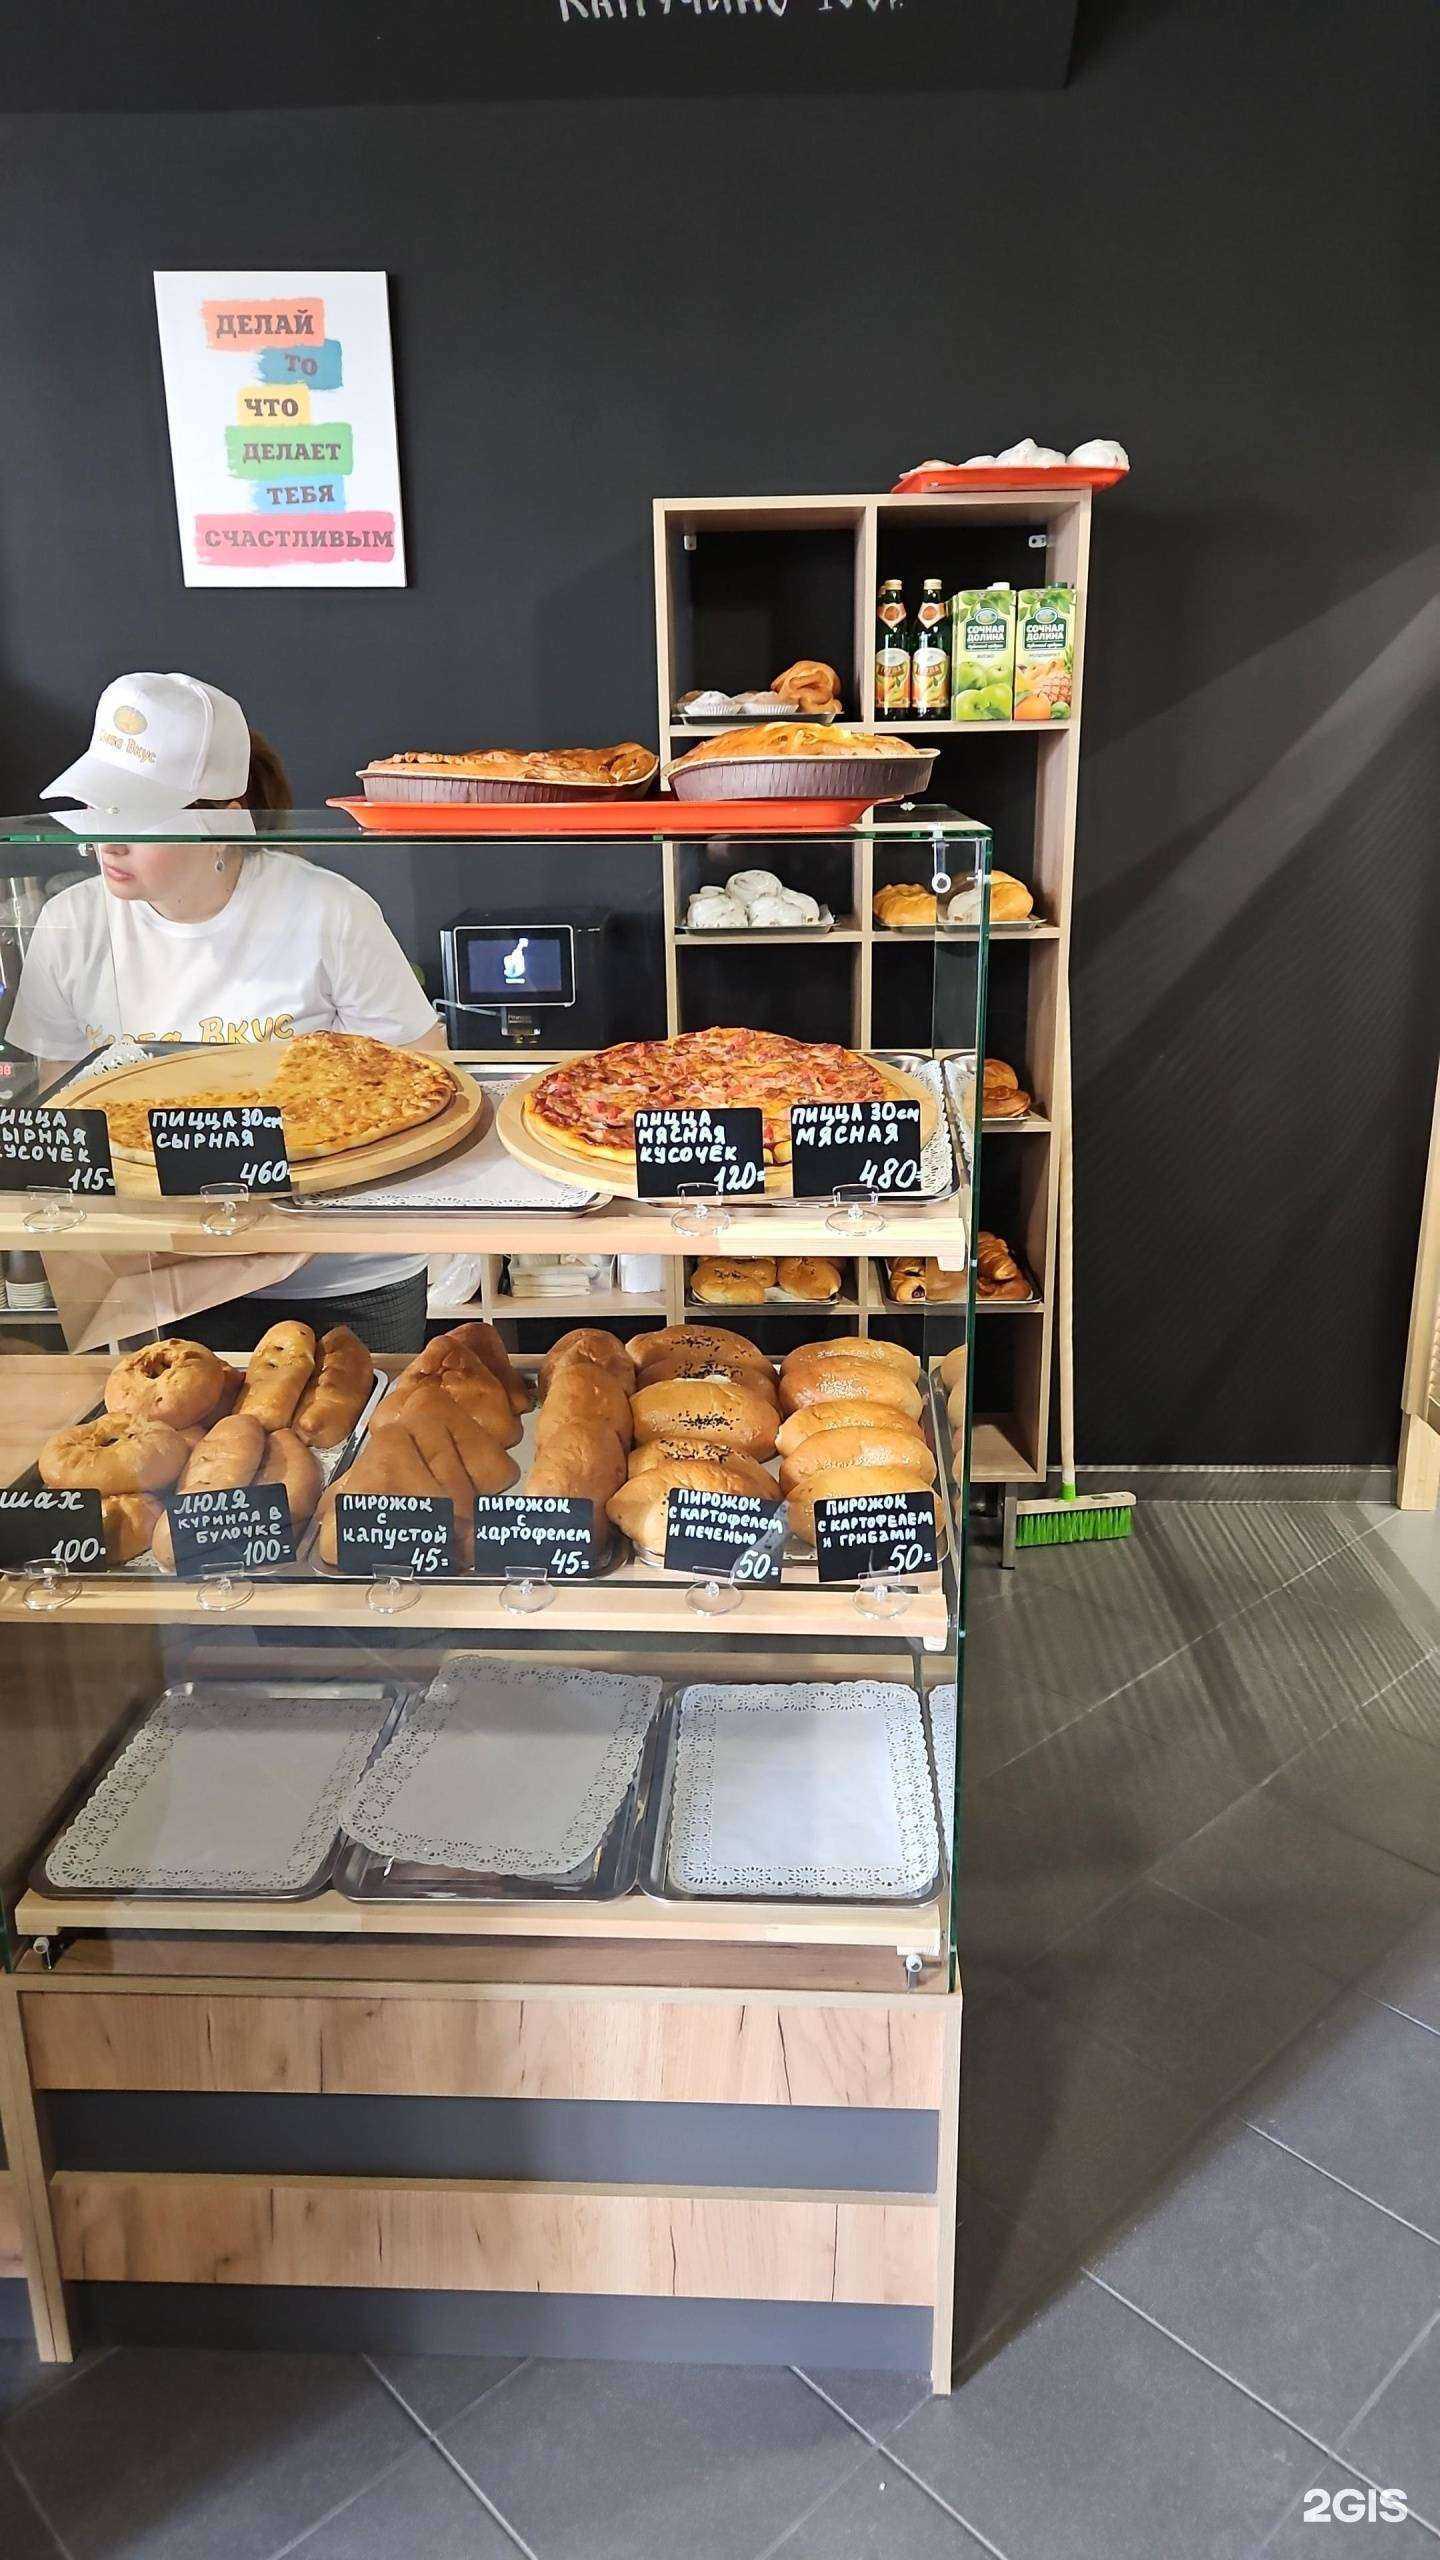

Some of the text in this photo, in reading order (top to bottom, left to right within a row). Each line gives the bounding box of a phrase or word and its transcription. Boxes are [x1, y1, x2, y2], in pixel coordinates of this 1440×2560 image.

[216, 309, 314, 337] ДЕЛАЙ
[284, 354, 317, 376] ТО
[244, 398, 299, 416] ЧТО
[243, 443, 341, 463] ДЕЛАЕТ
[266, 484, 333, 505] ТЕБЯ
[205, 529, 394, 548] СЧАСТЛИВЫМ
[967, 625, 1004, 634] СОЧНАЯ
[967, 633, 1005, 642] ДОЛИНА
[1027, 624, 1064, 633] СОЧНАЯ
[1027, 632, 1064, 641] ДОЛИНА
[0, 1108, 67, 1128] ИЦЦА
[152, 1110, 237, 1130] ПИЦЦА
[636, 1110, 711, 1128] ПИЦЦА
[792, 1103, 862, 1126] ПИЦЦА
[2, 1127, 87, 1146] ЫРНАЯ
[156, 1129, 255, 1150] СЫРНАЯ
[638, 1125, 726, 1145] МЯСНАЯ
[796, 1123, 899, 1147] МЯСНАЯ
[0, 1144, 91, 1163] УСОЧЕК
[640, 1145, 738, 1164] КУСОЧЕК
[174, 1489, 250, 1515] ЛЮЛЯ
[342, 1495, 433, 1513] ПИРОЖОК
[478, 1496, 571, 1513] ПИРОЖОК
[678, 1489, 761, 1512] ПИРОЖОК
[826, 1494, 907, 1516] ПИРОЖОК
[178, 1510, 260, 1530] КУРИНАЯ
[830, 1511, 934, 1532] КАРТОФЕЛЕМ
[343, 1524, 447, 1549] капустой
[685, 1524, 757, 1545] ПЕЧЕНЬЮ
